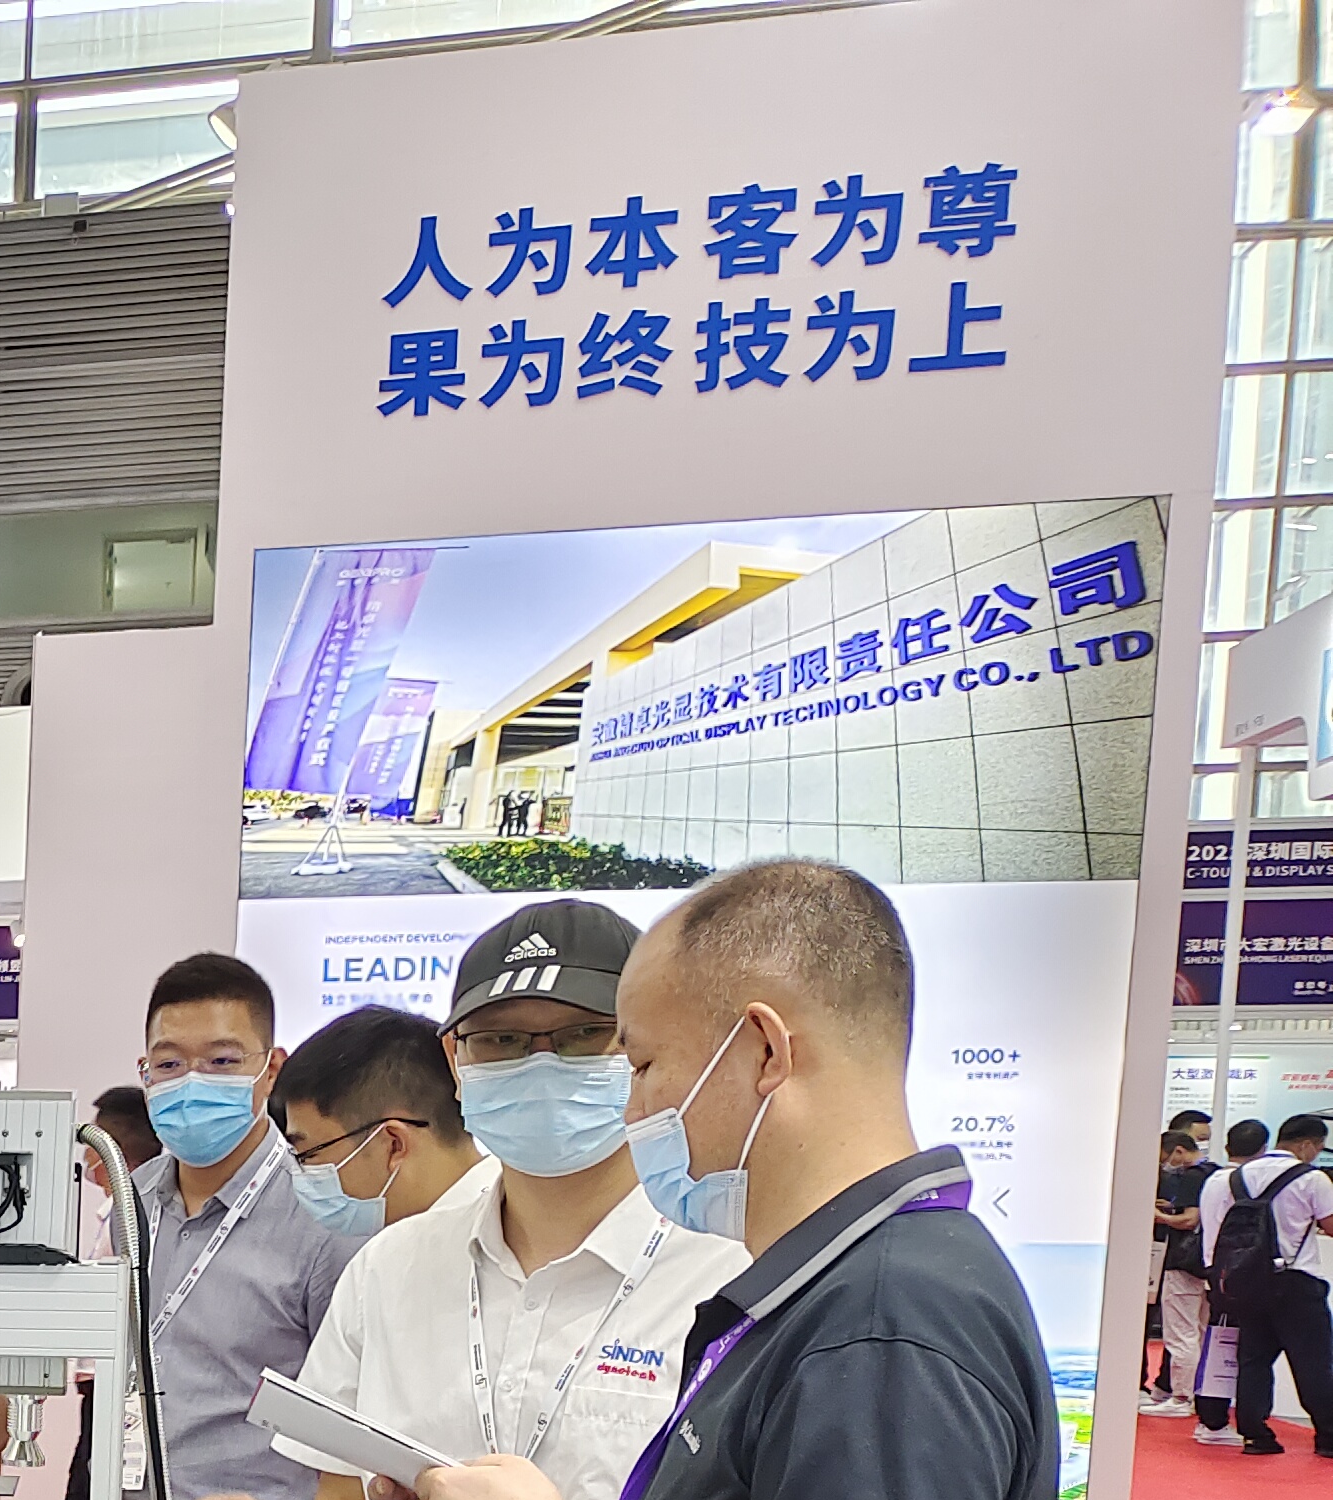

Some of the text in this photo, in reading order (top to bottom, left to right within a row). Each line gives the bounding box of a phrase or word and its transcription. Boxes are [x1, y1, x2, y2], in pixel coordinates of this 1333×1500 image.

[704, 715, 767, 740] DISPLAY
[772, 674, 944, 730] TECHNOLOGY
[1050, 629, 1157, 673] LTD
[1265, 864, 1324, 878] DISPLAY
[504, 946, 557, 963] adidas
[951, 1114, 1015, 1133] 20.7%
